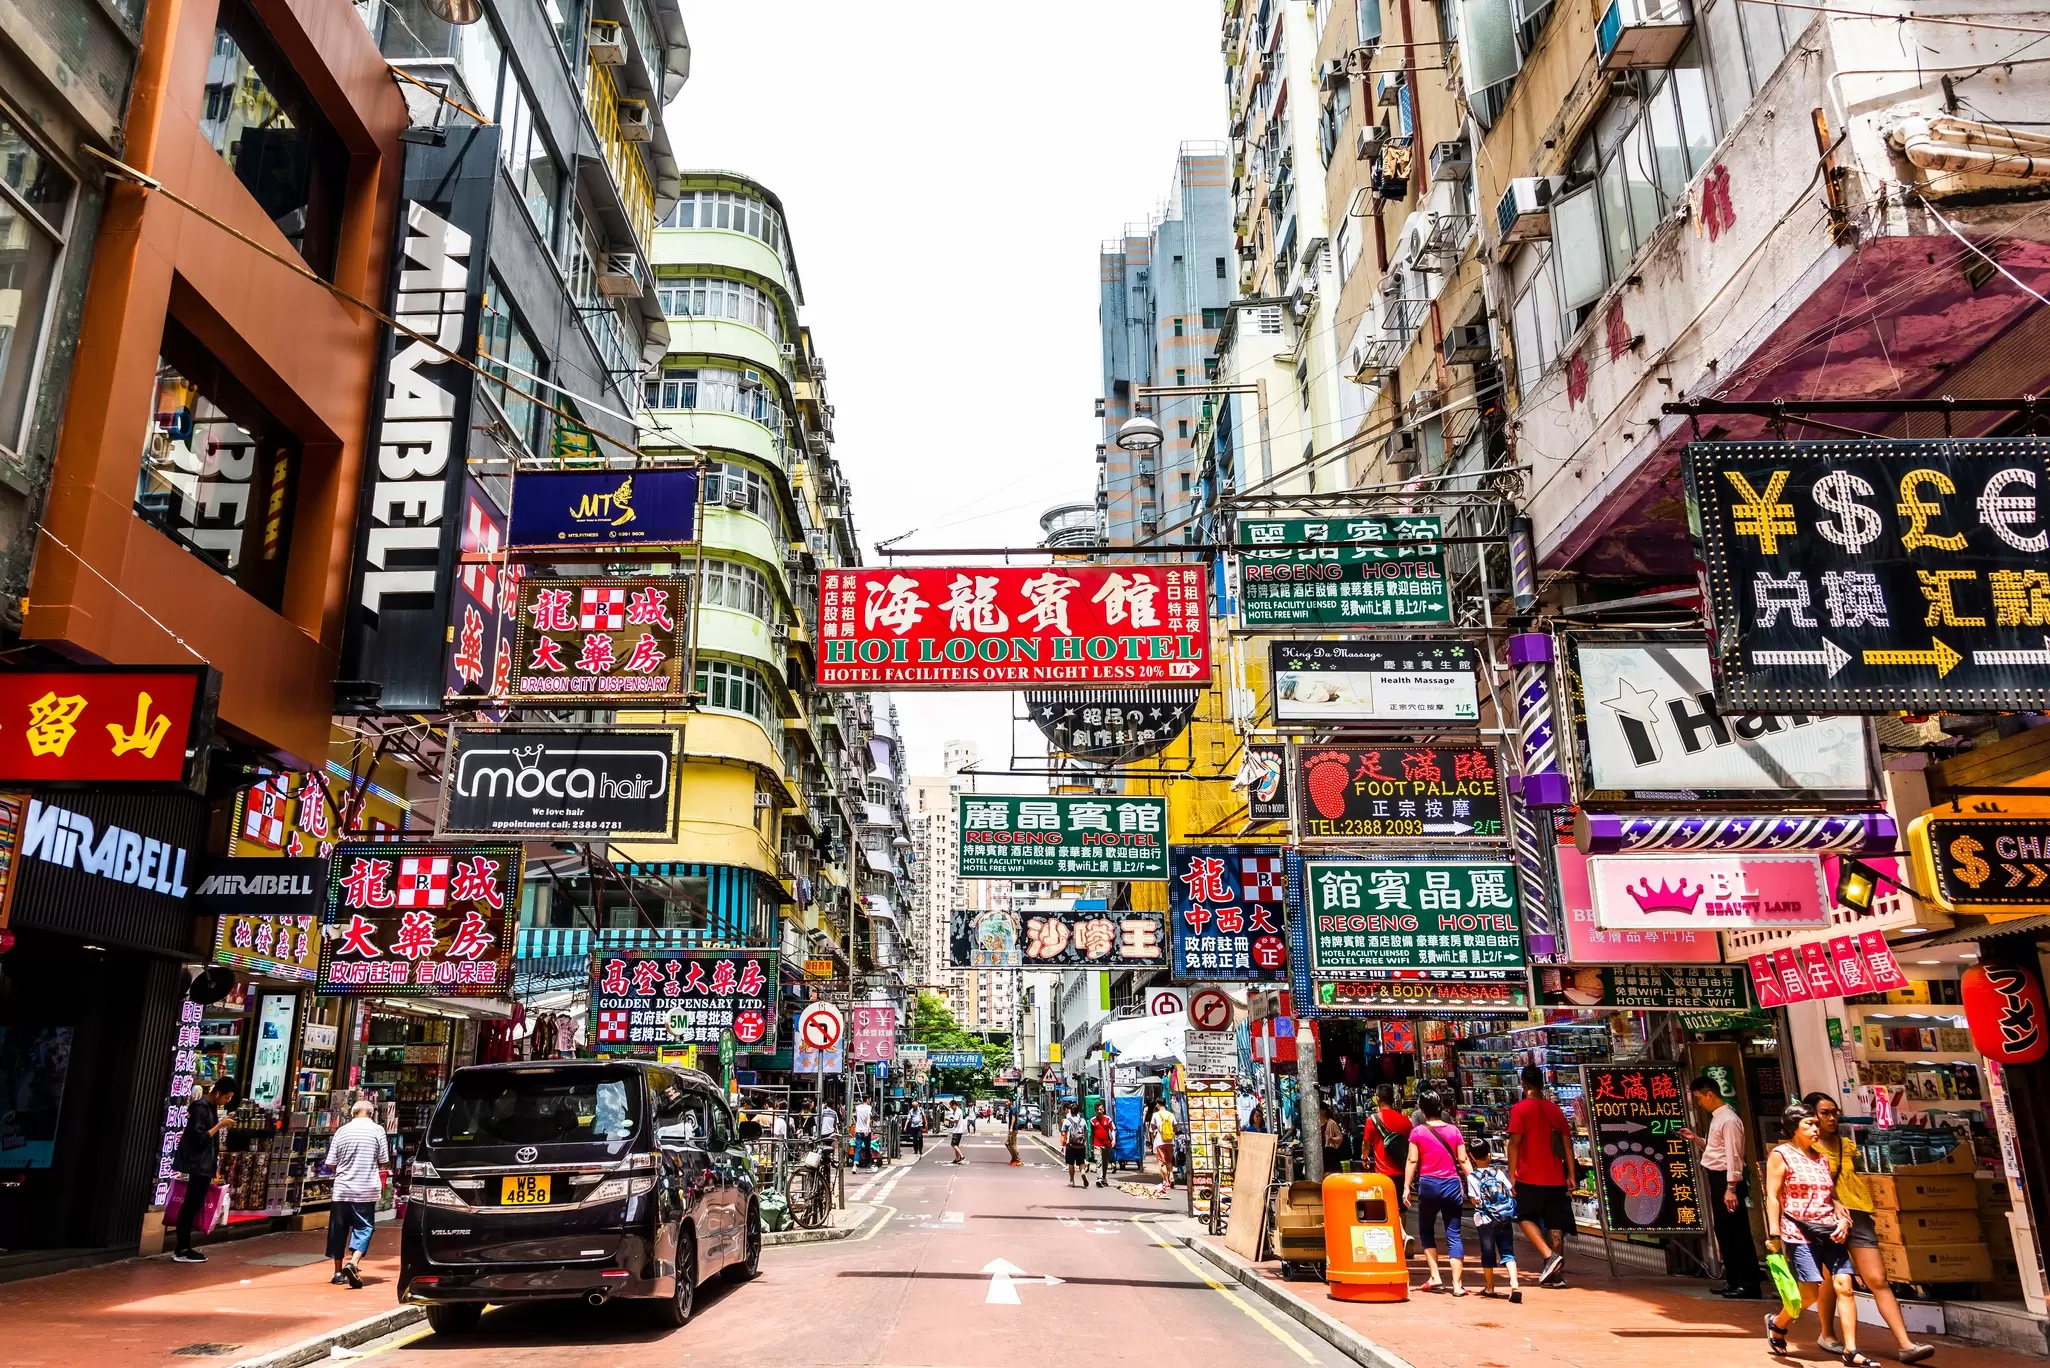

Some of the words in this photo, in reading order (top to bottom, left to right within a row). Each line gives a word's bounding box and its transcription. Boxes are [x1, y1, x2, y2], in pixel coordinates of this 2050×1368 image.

[1245, 563, 1343, 581] REGENG
[1362, 561, 1442, 579] HOTEL
[1246, 583, 1290, 598] 持牌賓館
[1293, 582, 1338, 598] 酒店設備
[1340, 581, 1385, 597] 豪華套房
[1386, 580, 1442, 596] 歡迎自由行
[823, 575, 839, 638] 酒店設備
[841, 574, 857, 638] 純粹租房
[865, 572, 1163, 636] 海龍賓館
[1166, 570, 1183, 632] 全日特平
[1183, 570, 1201, 633] 時租過夜
[1248, 601, 1272, 609] HOTEL
[1273, 600, 1306, 609] FACILITY
[1306, 600, 1337, 609] LIENSED
[1248, 610, 1273, 619] HOTEL
[1273, 610, 1292, 618] FREE
[1292, 610, 1309, 618] WIFI
[528, 633, 667, 675] 大藥房
[824, 637, 909, 664] HOI
[918, 636, 1042, 663] LOON
[1050, 635, 1202, 662] HOTEL
[1333, 647, 1383, 660] Massage
[824, 668, 882, 681] HOTEL
[885, 667, 979, 680] FACILITEIS
[983, 667, 1029, 680] OVER
[1033, 666, 1089, 679] NIGHT
[1093, 665, 1135, 678] LESS
[1139, 665, 1164, 678] 20%
[1171, 663, 1195, 675] 1/F
[520, 677, 569, 692] DRAGON
[569, 677, 597, 692] CITY
[598, 676, 670, 692] DISPENSARY
[1380, 676, 1412, 684] Health
[1414, 676, 1455, 686] Massage
[1455, 703, 1472, 712] 1/F
[0, 691, 172, 758] 留山
[1665, 690, 1842, 756] Ha
[471, 768, 596, 799] moca
[599, 773, 653, 799] hair
[1355, 781, 1409, 796] FOOT
[1413, 780, 1497, 796] PALACE
[532, 807, 544, 816] We
[545, 807, 564, 816] love
[565, 807, 584, 816] hair
[1255, 803, 1267, 813] FOOT
[1272, 803, 1285, 813] BODY
[1372, 799, 1471, 818] 正宗按摩
[492, 819, 550, 829] appointment
[551, 819, 571, 829] call:
[572, 820, 597, 829] 2388
[599, 820, 622, 829] 4781
[963, 801, 1161, 833] 麗晶賓館
[1385, 819, 1423, 835] 2093
[1473, 819, 1501, 835] 2/F
[965, 830, 1063, 845] REGENG
[1082, 832, 1160, 847] HOTEL
[963, 844, 1008, 857] 持牌賓館
[1010, 845, 1056, 857] 酒店設備
[1058, 846, 1103, 858] 豪華套房
[1105, 847, 1162, 859] 歡迎自由行
[1995, 836, 2050, 859] CH
[989, 858, 1022, 866] FACILITY
[1022, 858, 1054, 866] LIENSED
[340, 856, 397, 909] 龍
[451, 855, 505, 910] 城
[1180, 856, 1234, 903] 龍
[1705, 902, 1761, 916] BEAUTY
[1764, 901, 1802, 913] LAND
[1319, 914, 1419, 932] REGENG
[1438, 913, 1519, 931] HOTEL
[336, 910, 495, 961] 大藥房
[1320, 935, 1365, 948] 持牌賓館
[1367, 935, 1414, 948] 酒店設備
[1416, 934, 1462, 947] 豪華套房
[1463, 934, 1520, 947] 歡迎自由行
[1184, 936, 1249, 952] 政府註冊
[1185, 952, 1250, 969] 免稅正貨
[1322, 957, 1358, 965] HOTEL
[1379, 949, 1410, 957] LIENSED
[328, 961, 410, 985] 政府註冊
[415, 961, 496, 985] 信心保證
[1335, 984, 1377, 997] FOOT
[1380, 984, 1389, 997] &
[1393, 985, 1434, 998] BODY
[1437, 986, 1510, 999] MASSAGE
[600, 998, 652, 1009] GOLDEN
[656, 998, 734, 1009] DISPENSARY
[738, 998, 766, 1009] LTD.
[1617, 997, 1659, 1006] HOTEL
[1667, 997, 1700, 1007] FREE
[1707, 998, 1736, 1007] WIFI
[670, 1015, 688, 1029] 5M
[1225, 1033, 1234, 1041] 12
[1595, 1102, 1628, 1117] FOOT
[1631, 1102, 1681, 1116] PALACE
[1877, 1100, 1893, 1126] 24
[516, 1176, 536, 1190] WB
[1666, 1139, 1698, 1226] 正宗按摩
[506, 1190, 546, 1203] 4858
